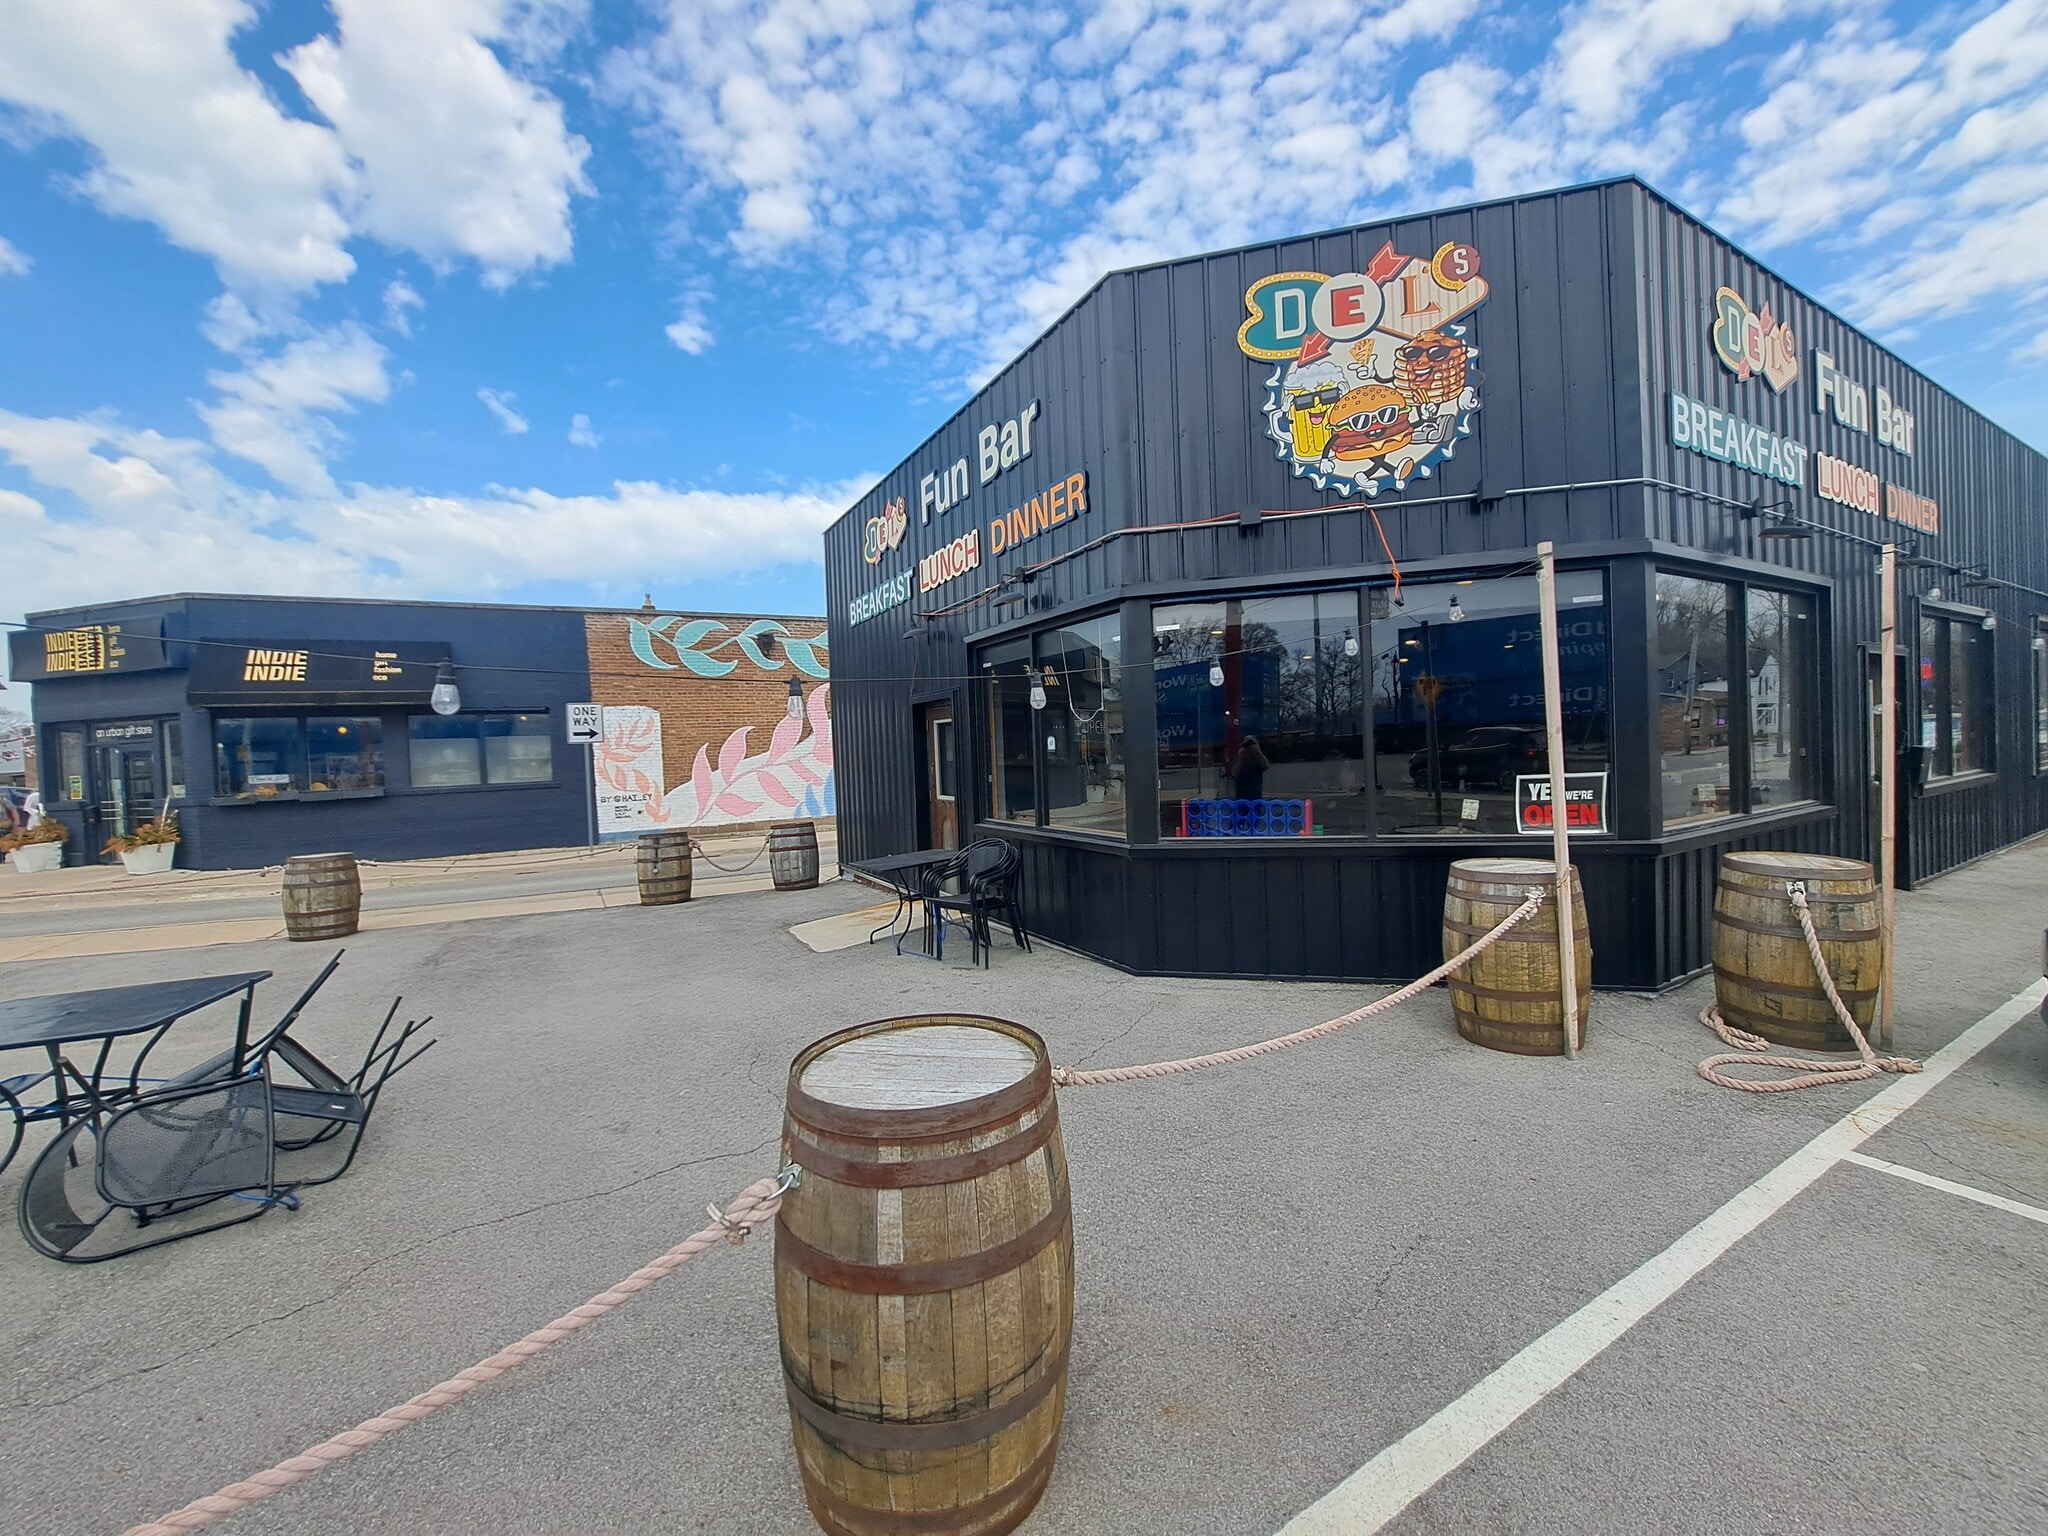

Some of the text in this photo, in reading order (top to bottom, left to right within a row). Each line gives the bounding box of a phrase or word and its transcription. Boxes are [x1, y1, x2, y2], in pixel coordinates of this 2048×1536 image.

[1816, 351, 1914, 454] Fun Bar
[1673, 394, 1807, 487] BREAKFAST
[920, 401, 1037, 524] Fun Bar
[1819, 454, 1879, 514] LUNCH
[991, 473, 1086, 555] DINNER
[1887, 485, 1938, 534] DINNER
[919, 532, 979, 592] LUNCH
[850, 569, 914, 626] BREAKFAST
[45, 631, 75, 652] INDIE
[246, 650, 309, 665] INDIE
[46, 651, 75, 672] INDIE
[243, 665, 308, 681] INDIE
[572, 717, 598, 726] WAY
[573, 706, 597, 716] ONE
[1528, 782, 1594, 801] YE WE'RE
[1523, 803, 1599, 827] OPEN
